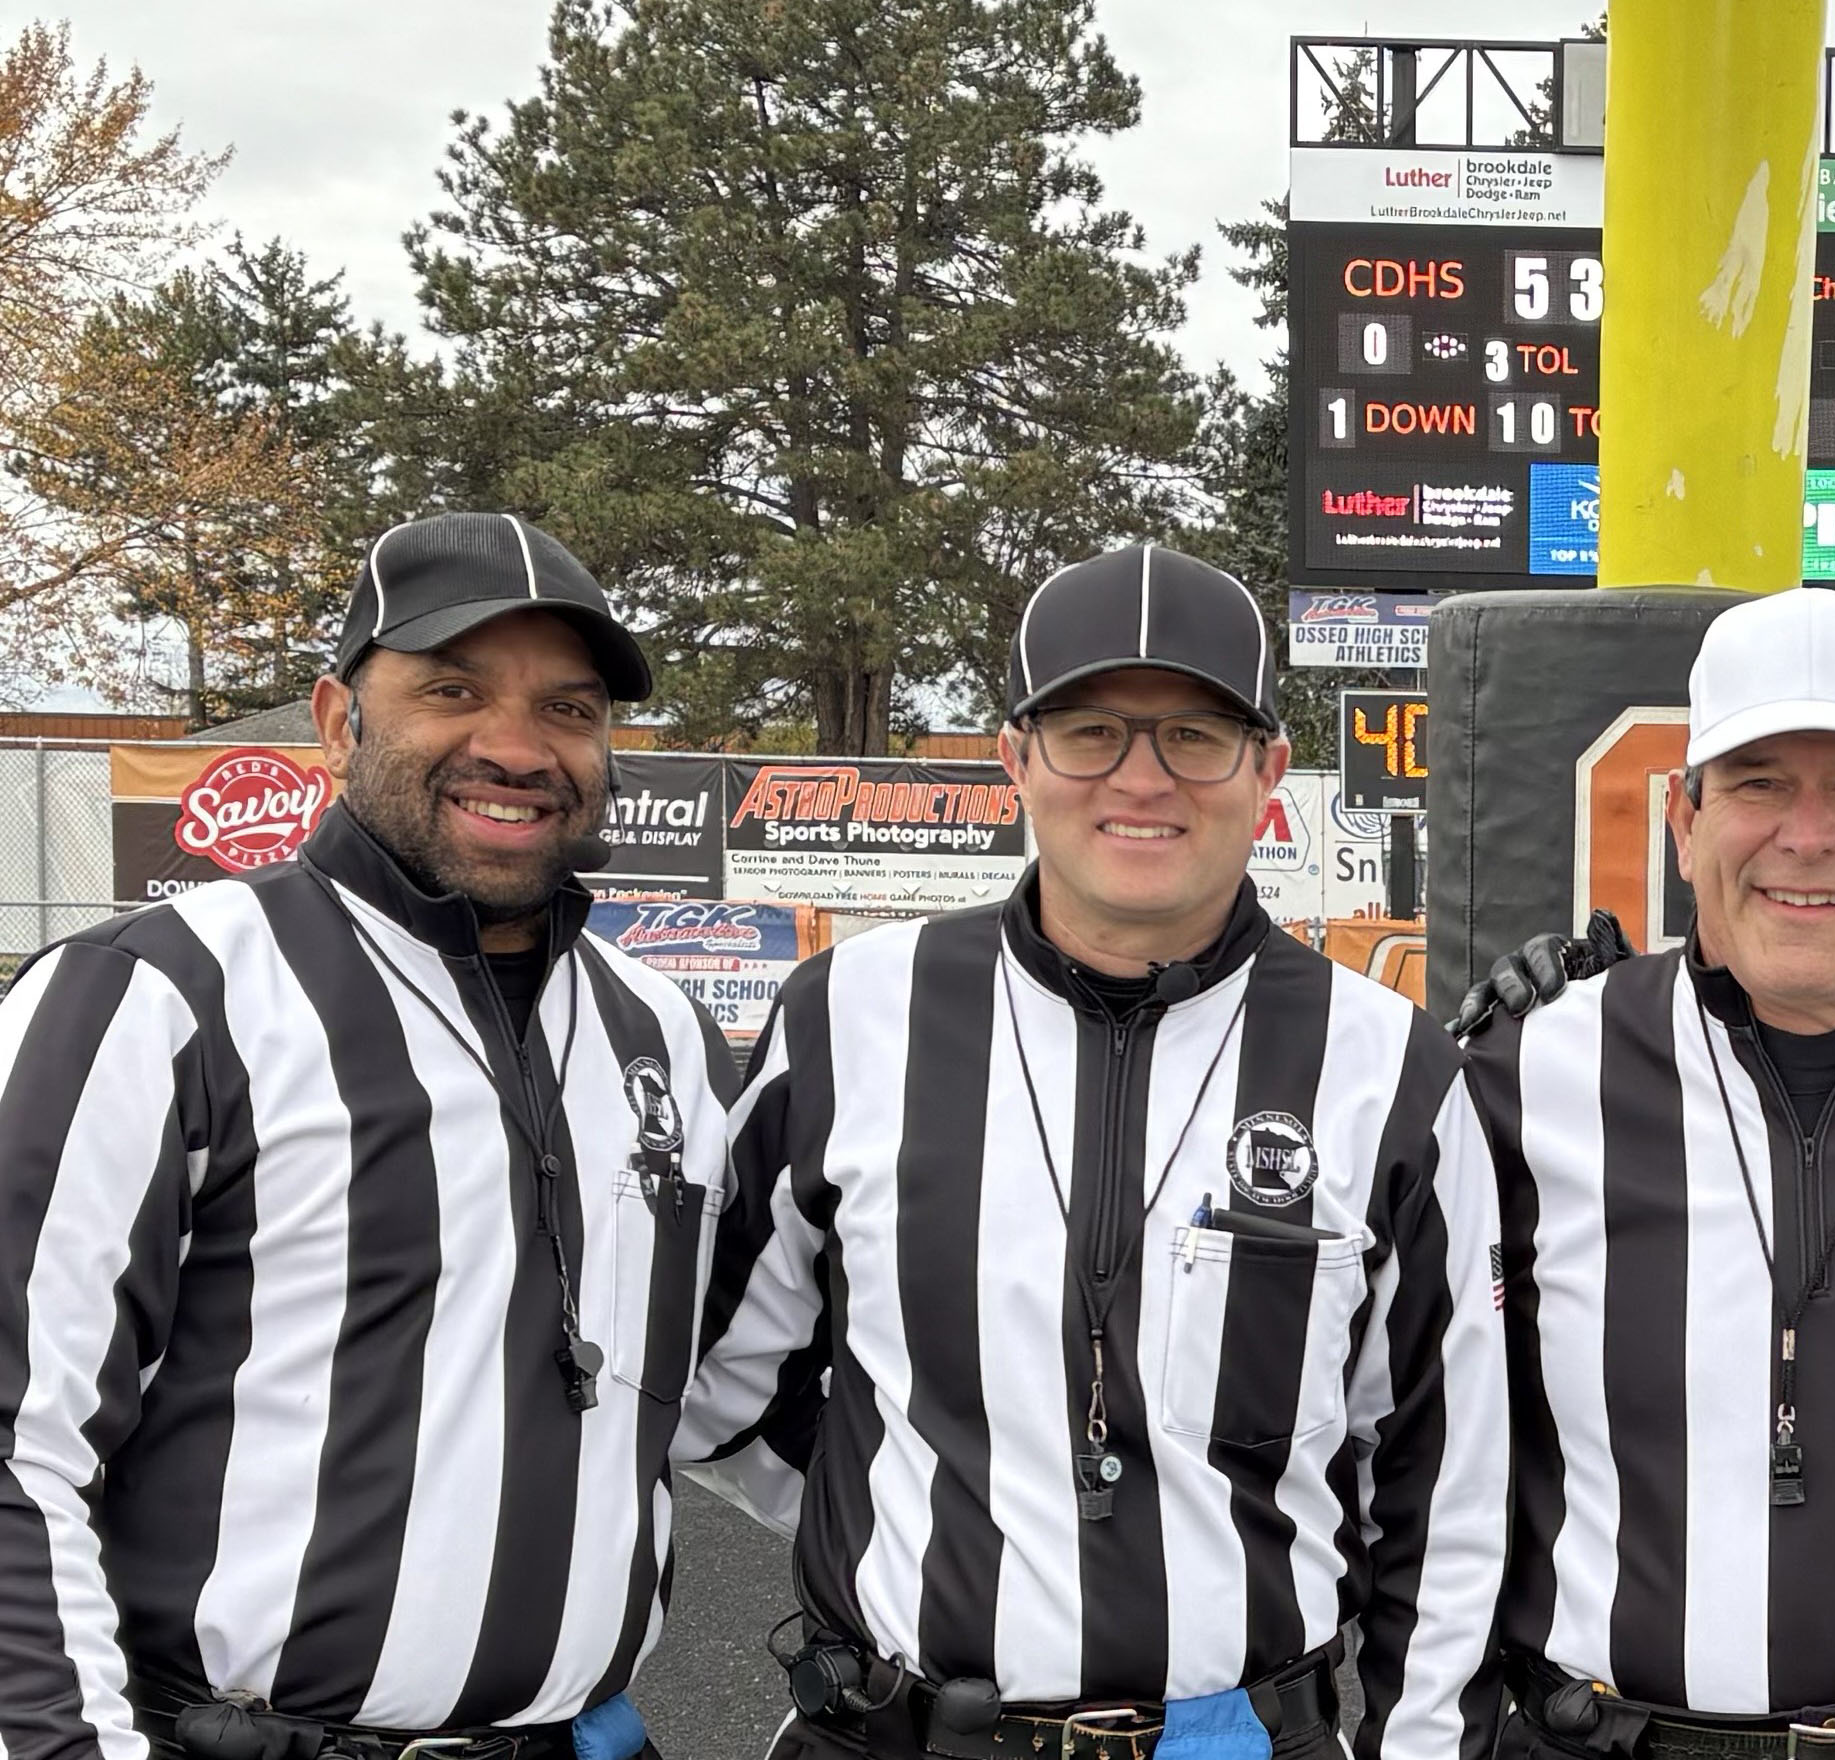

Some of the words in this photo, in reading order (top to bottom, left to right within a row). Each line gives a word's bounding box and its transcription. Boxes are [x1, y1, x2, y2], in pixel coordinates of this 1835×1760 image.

[1386, 167, 1452, 188] Luther
[1466, 159, 1552, 175] brookdale
[1344, 258, 1465, 298] CDHS
[1363, 322, 1387, 365] 0
[1485, 340, 1509, 382] 3
[1516, 346, 1579, 374] TOL
[1328, 398, 1346, 439] 1
[1366, 403, 1476, 434] DOWN
[1323, 489, 1410, 516] Luther
[1296, 627, 1348, 644] OSSEO
[1355, 627, 1393, 644] HIGH
[1336, 646, 1421, 663] ATHLETICS
[183, 774, 325, 848] Savoy
[641, 831, 702, 846] DISPLAY
[765, 822, 840, 844] Sports
[848, 822, 995, 849] Photography
[227, 845, 291, 866] PIZZA
[782, 855, 804, 864] and
[809, 855, 839, 865] Dave
[893, 870, 931, 878] POSTERS
